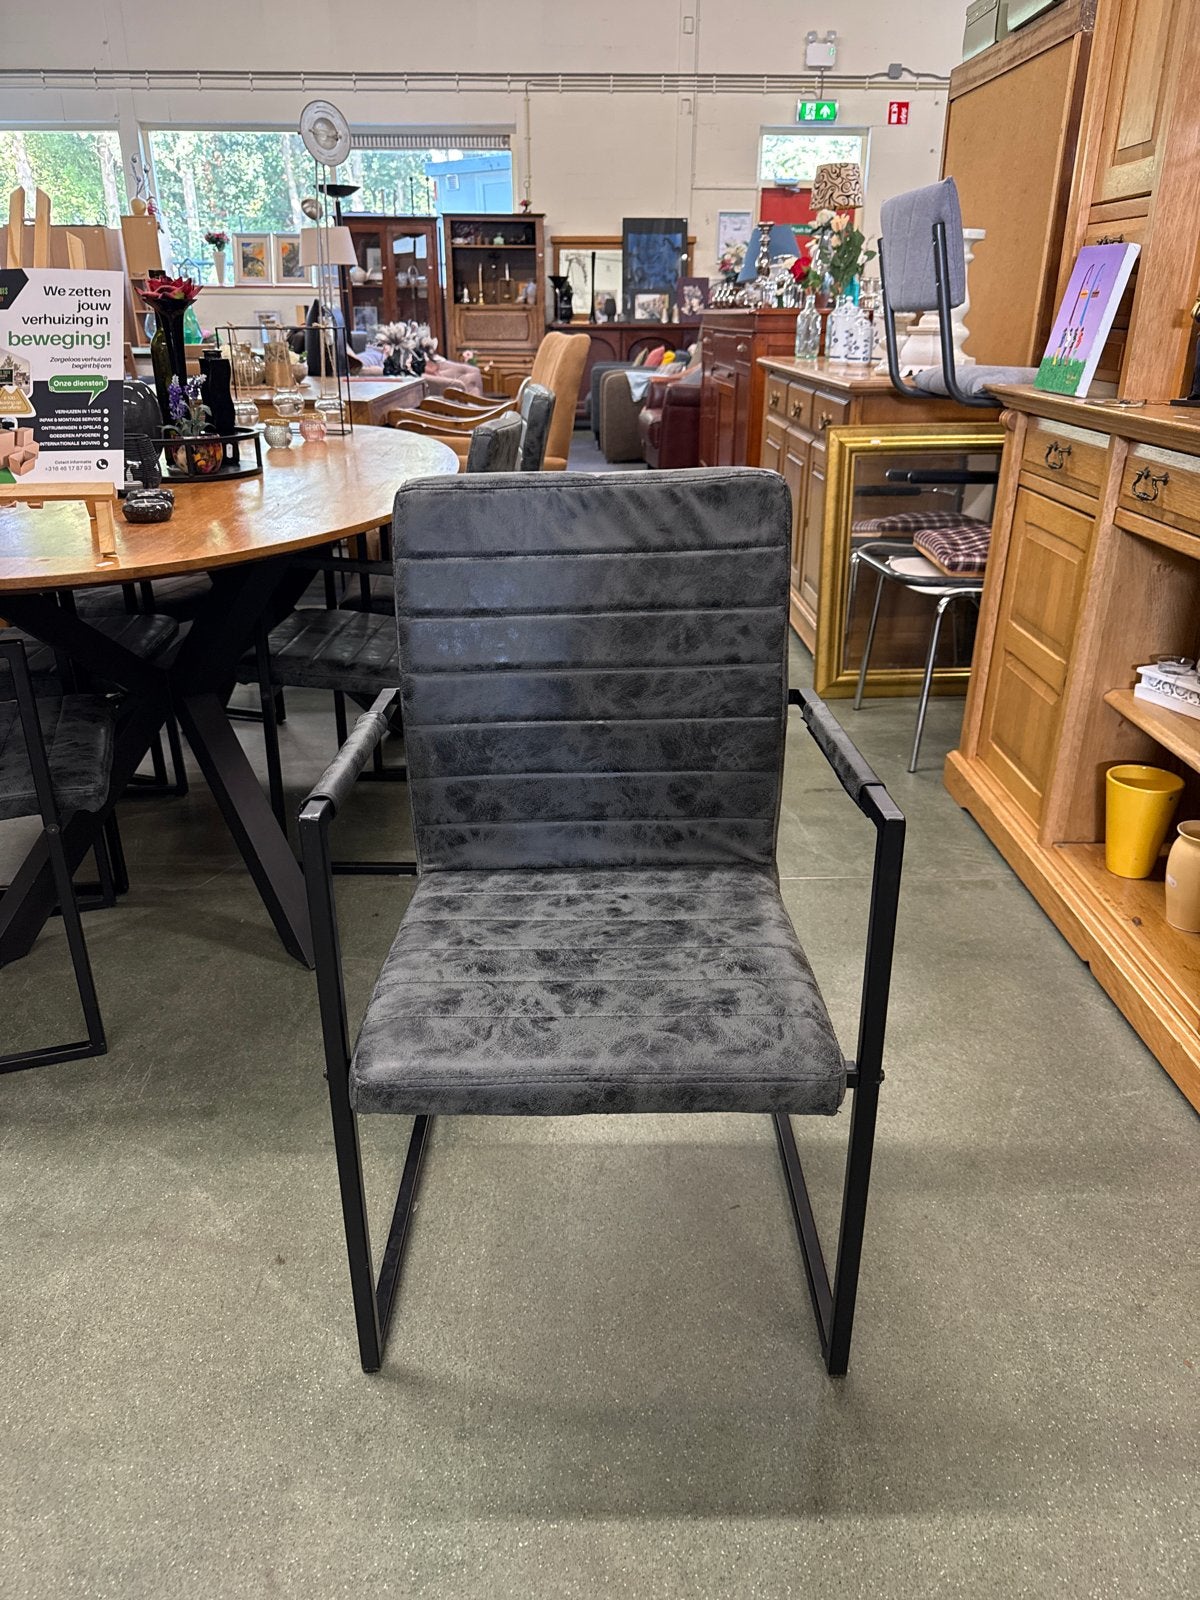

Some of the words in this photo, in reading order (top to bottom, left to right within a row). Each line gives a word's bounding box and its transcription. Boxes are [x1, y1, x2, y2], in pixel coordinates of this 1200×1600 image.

[43, 285, 66, 297] We
[68, 287, 111, 297] zetten
[77, 300, 111, 313] jouw
[22, 314, 94, 327] verhuizing
[96, 314, 109, 325] in
[8, 331, 111, 350] beweging!
